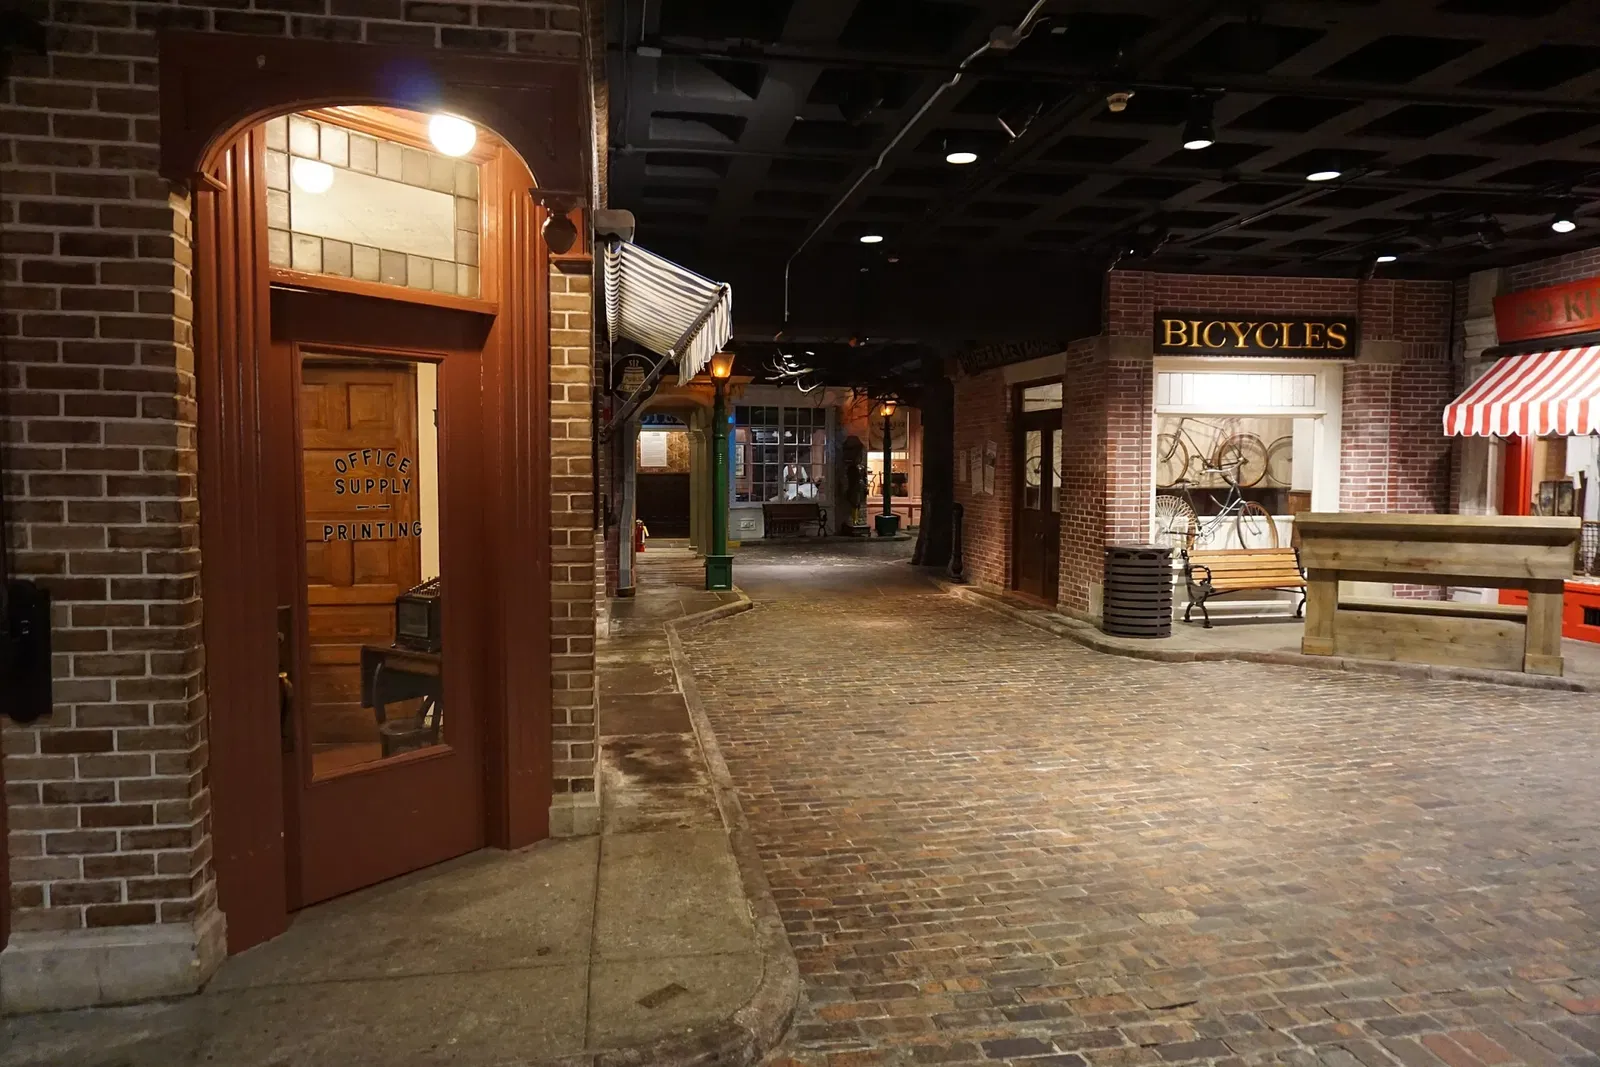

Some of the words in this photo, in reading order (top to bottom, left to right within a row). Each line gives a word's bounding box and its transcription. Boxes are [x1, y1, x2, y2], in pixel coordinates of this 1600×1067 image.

[1162, 319, 1348, 351] BICYCLES
[334, 448, 412, 475] OFFICE
[334, 477, 411, 495] SUPPLY
[323, 521, 422, 541] PRINTING
